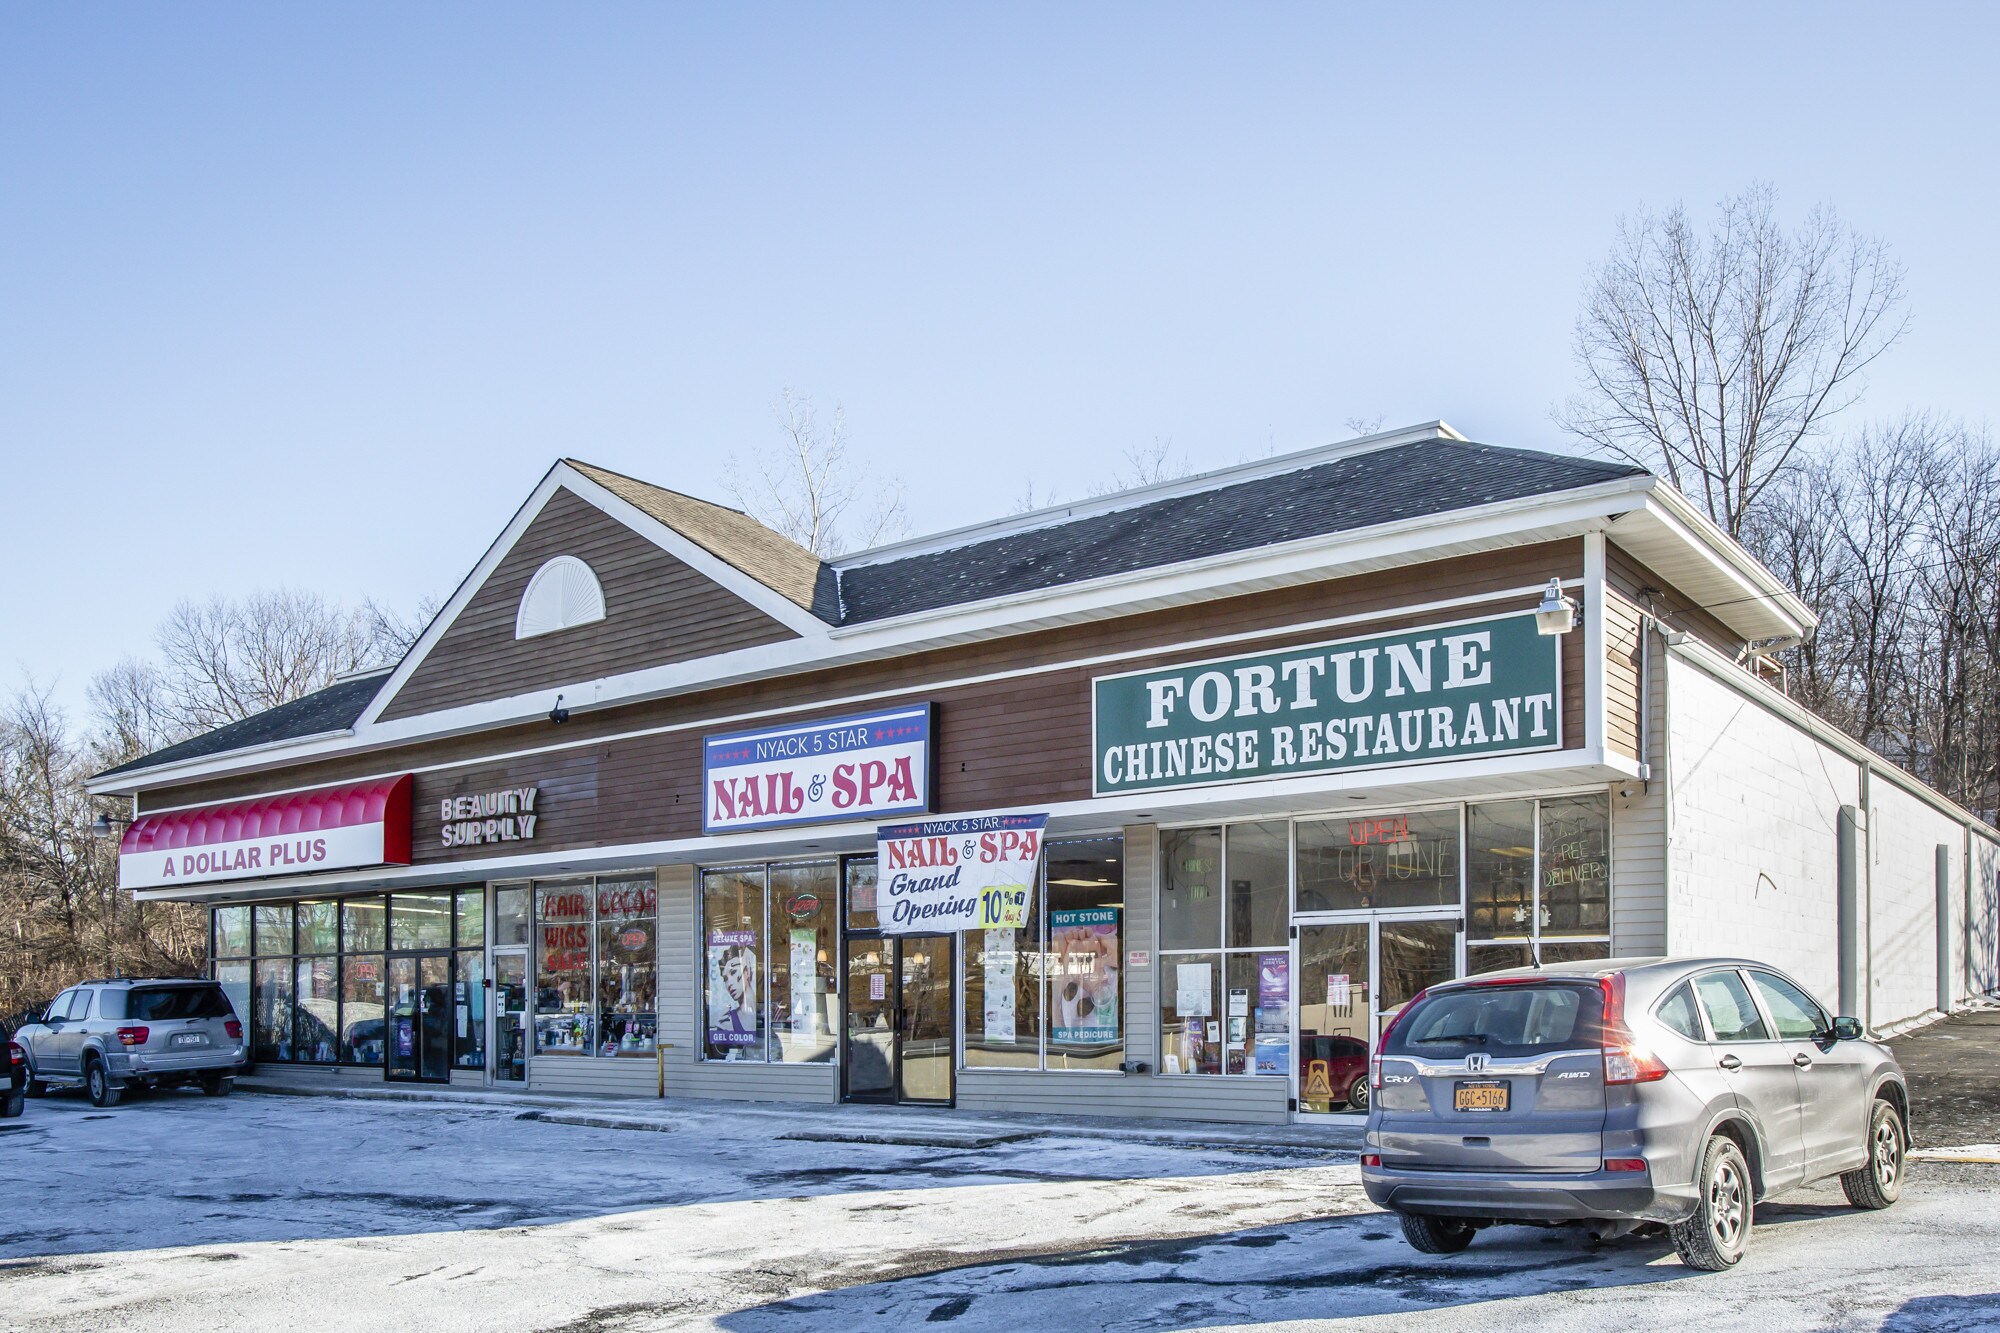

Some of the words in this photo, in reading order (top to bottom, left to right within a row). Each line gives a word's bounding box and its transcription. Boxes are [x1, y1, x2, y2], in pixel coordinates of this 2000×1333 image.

[1146, 630, 1492, 729] FORTUNE
[756, 736, 808, 760] NYACK
[813, 734, 823, 752] 5
[828, 728, 868, 749] STAR
[1103, 729, 1259, 785] CHINESE
[1271, 692, 1552, 767] RESTAURANT
[713, 771, 804, 821] NAIL
[807, 774, 827, 803] &
[831, 755, 918, 809] SPA
[441, 787, 537, 821] BEAUTY
[441, 814, 537, 847] SUPPLY
[923, 820, 959, 835] NYACK
[961, 819, 968, 831] 5
[972, 817, 999, 830] STAR
[1350, 815, 1408, 845] OPEN
[162, 857, 176, 878] A
[183, 847, 262, 877] DOLLAR
[270, 838, 327, 867] PLUS
[887, 836, 959, 870] NAIL
[962, 840, 977, 860] &
[979, 830, 1039, 864] SPA
[1552, 840, 1590, 861] FREE
[889, 864, 962, 897] Grand
[1542, 862, 1610, 887] DELIVERY
[544, 894, 586, 917] HAIR
[785, 896, 820, 914] Open
[892, 895, 978, 926] Opening
[1055, 913, 1076, 924] HOT
[1079, 911, 1114, 922] STONE
[544, 925, 587, 948] WIGS
[621, 931, 647, 946] OPEN
[712, 935, 738, 944] DELUXE
[739, 934, 753, 942] SPA
[356, 963, 376, 978] OPEN
[547, 952, 587, 971] SALE
[713, 1033, 727, 1042] GEL
[728, 1033, 754, 1042] COLOR
[1058, 1031, 1073, 1039] SPA
[1074, 1030, 1114, 1039] PEDICURE
[1557, 1071, 1591, 1079] AWD
